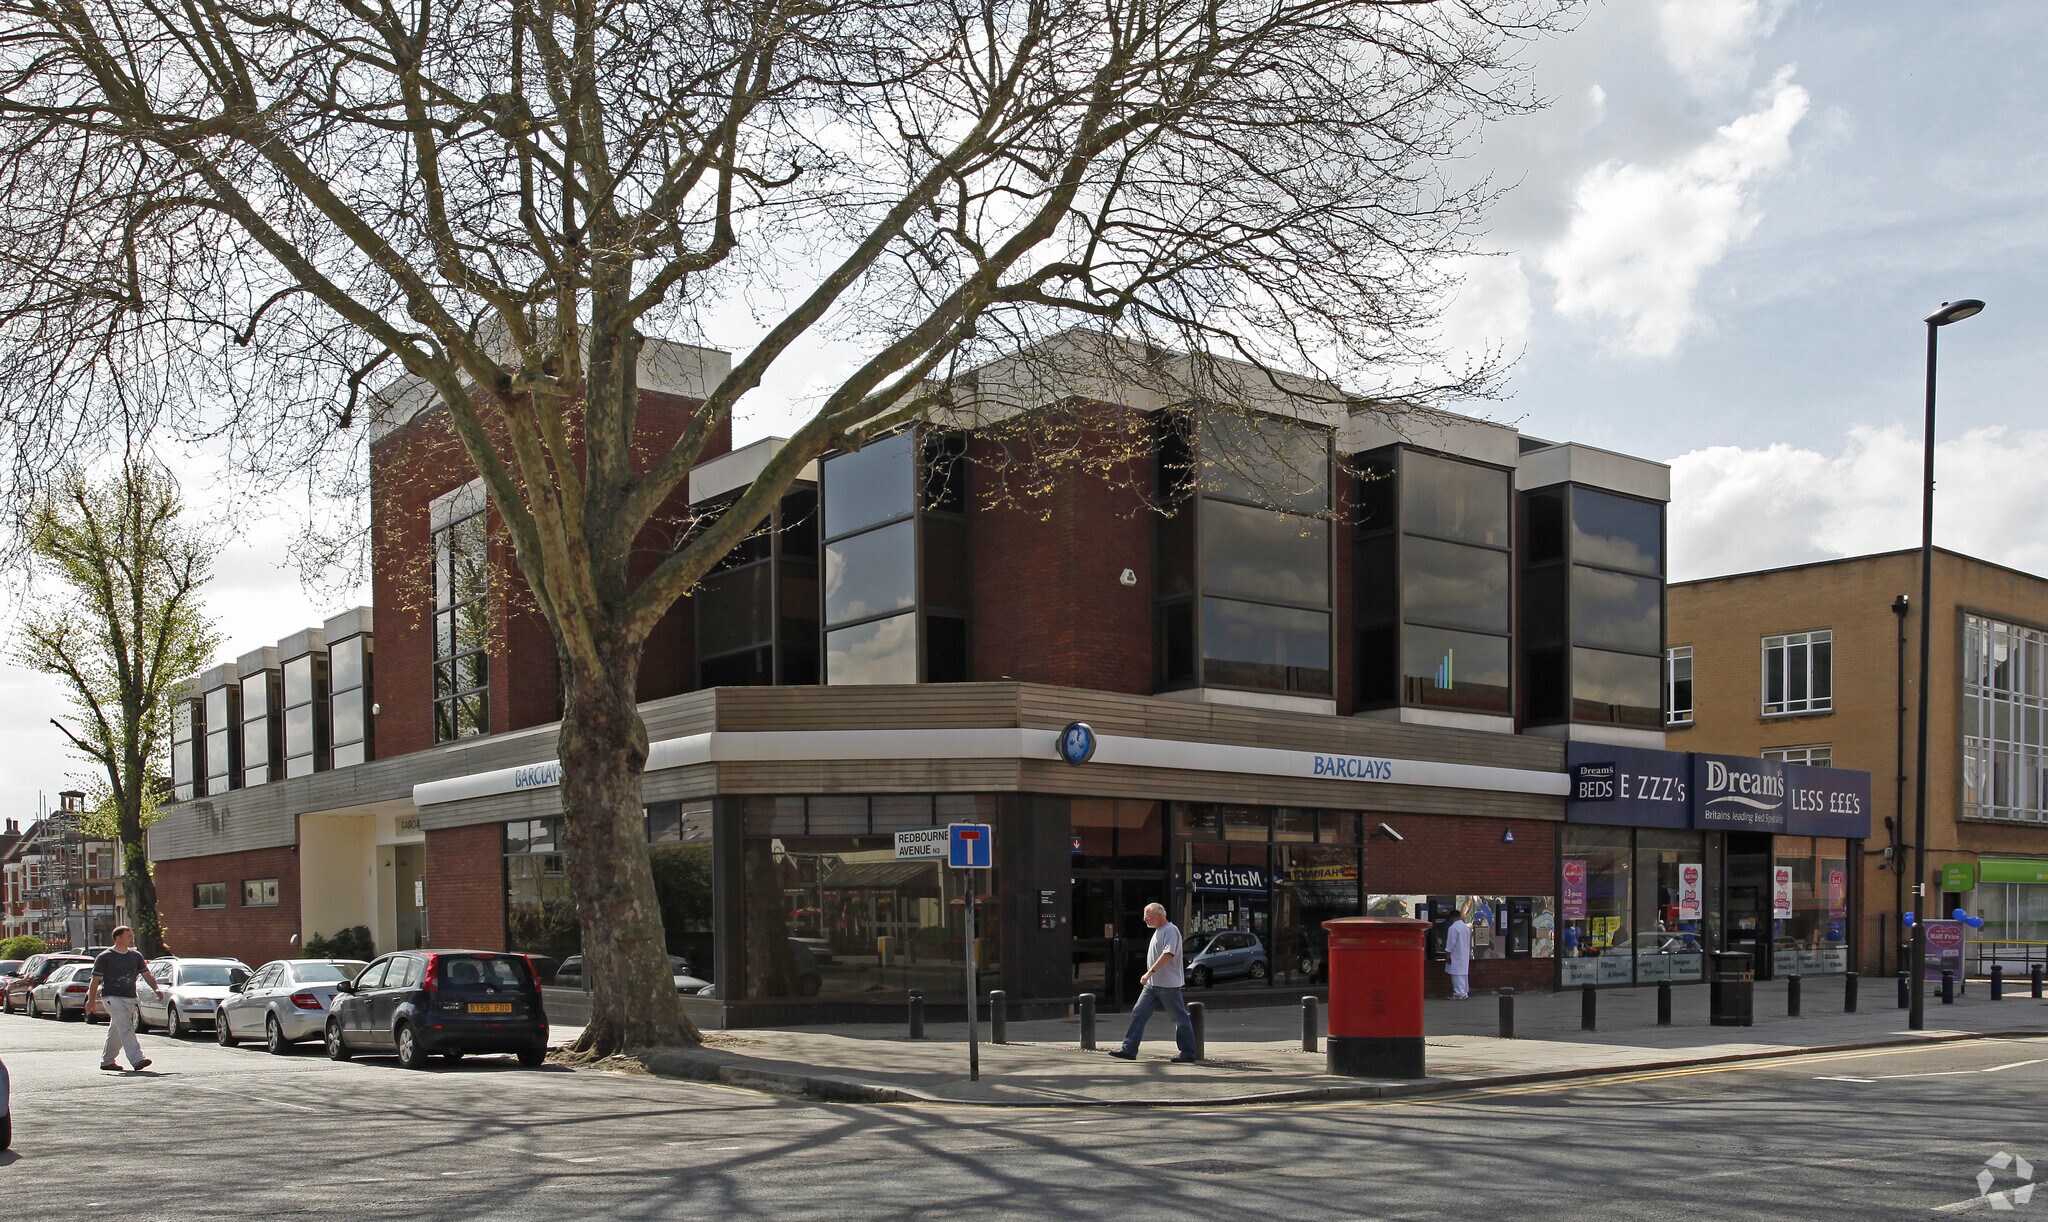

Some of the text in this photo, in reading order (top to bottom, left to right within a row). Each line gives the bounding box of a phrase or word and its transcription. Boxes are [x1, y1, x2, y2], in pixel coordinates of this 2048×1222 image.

[1313, 755, 1392, 780] BARCLAYS
[1580, 766, 1614, 775] Dreams
[1706, 760, 1784, 797] Dreams
[1579, 781, 1613, 798] BEDS
[1792, 788, 1824, 812] LESS
[898, 830, 948, 844] REDBOURNE
[899, 845, 931, 856] AVENUE
[470, 1004, 491, 1012] BT56
